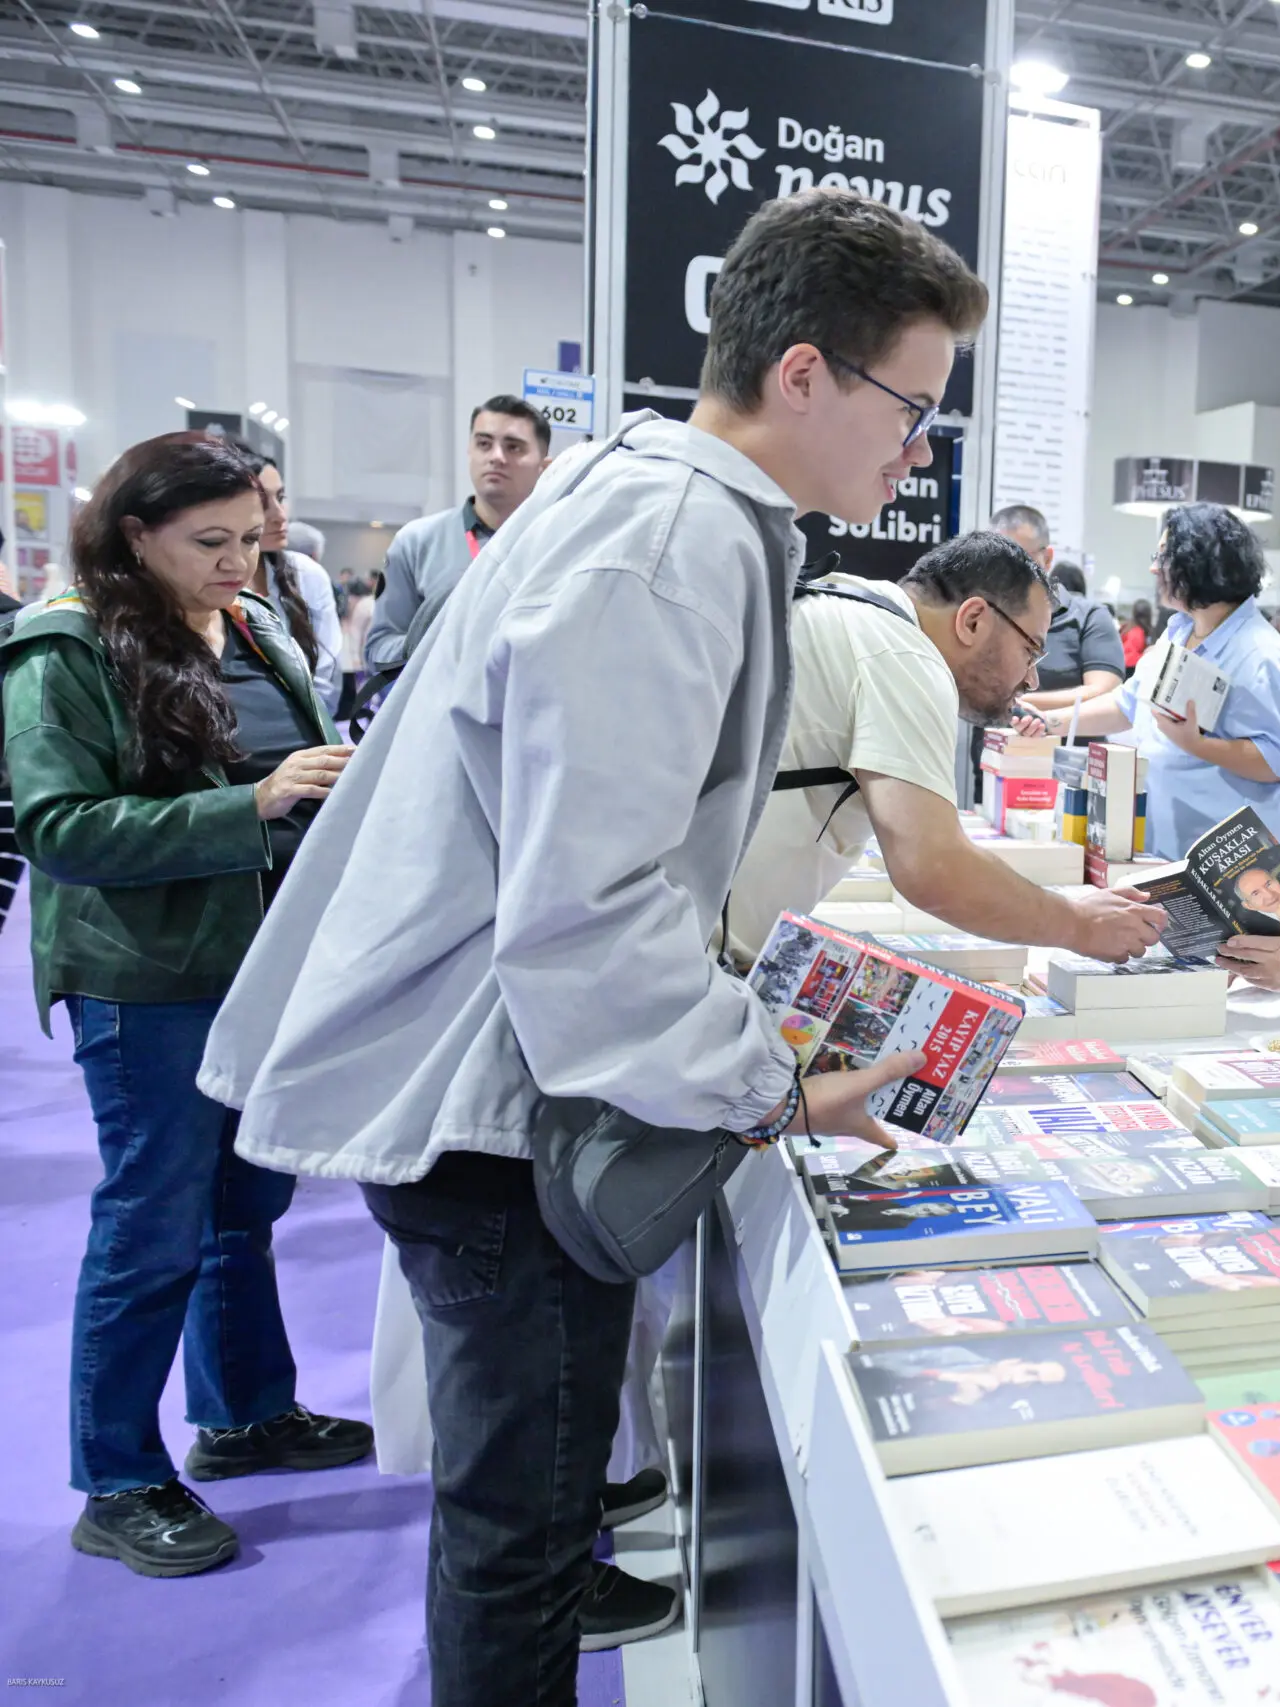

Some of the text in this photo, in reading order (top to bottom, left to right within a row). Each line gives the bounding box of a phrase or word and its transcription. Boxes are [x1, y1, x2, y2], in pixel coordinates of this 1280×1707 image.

[778, 117, 885, 163] Doğan
[541, 406, 577, 423] 602
[1199, 826, 1259, 875] KUŞAKLAR
[1218, 843, 1253, 873] ARASI
[928, 1023, 953, 1054] 2015
[931, 1008, 980, 1080] KAYIP YAZ
[891, 1082, 917, 1118] Öymen
[913, 1087, 938, 1117] Altan
[950, 1191, 1006, 1226] BEY
[1180, 1590, 1252, 1671] AYSEVER
[1215, 1583, 1273, 1644] ENVER
